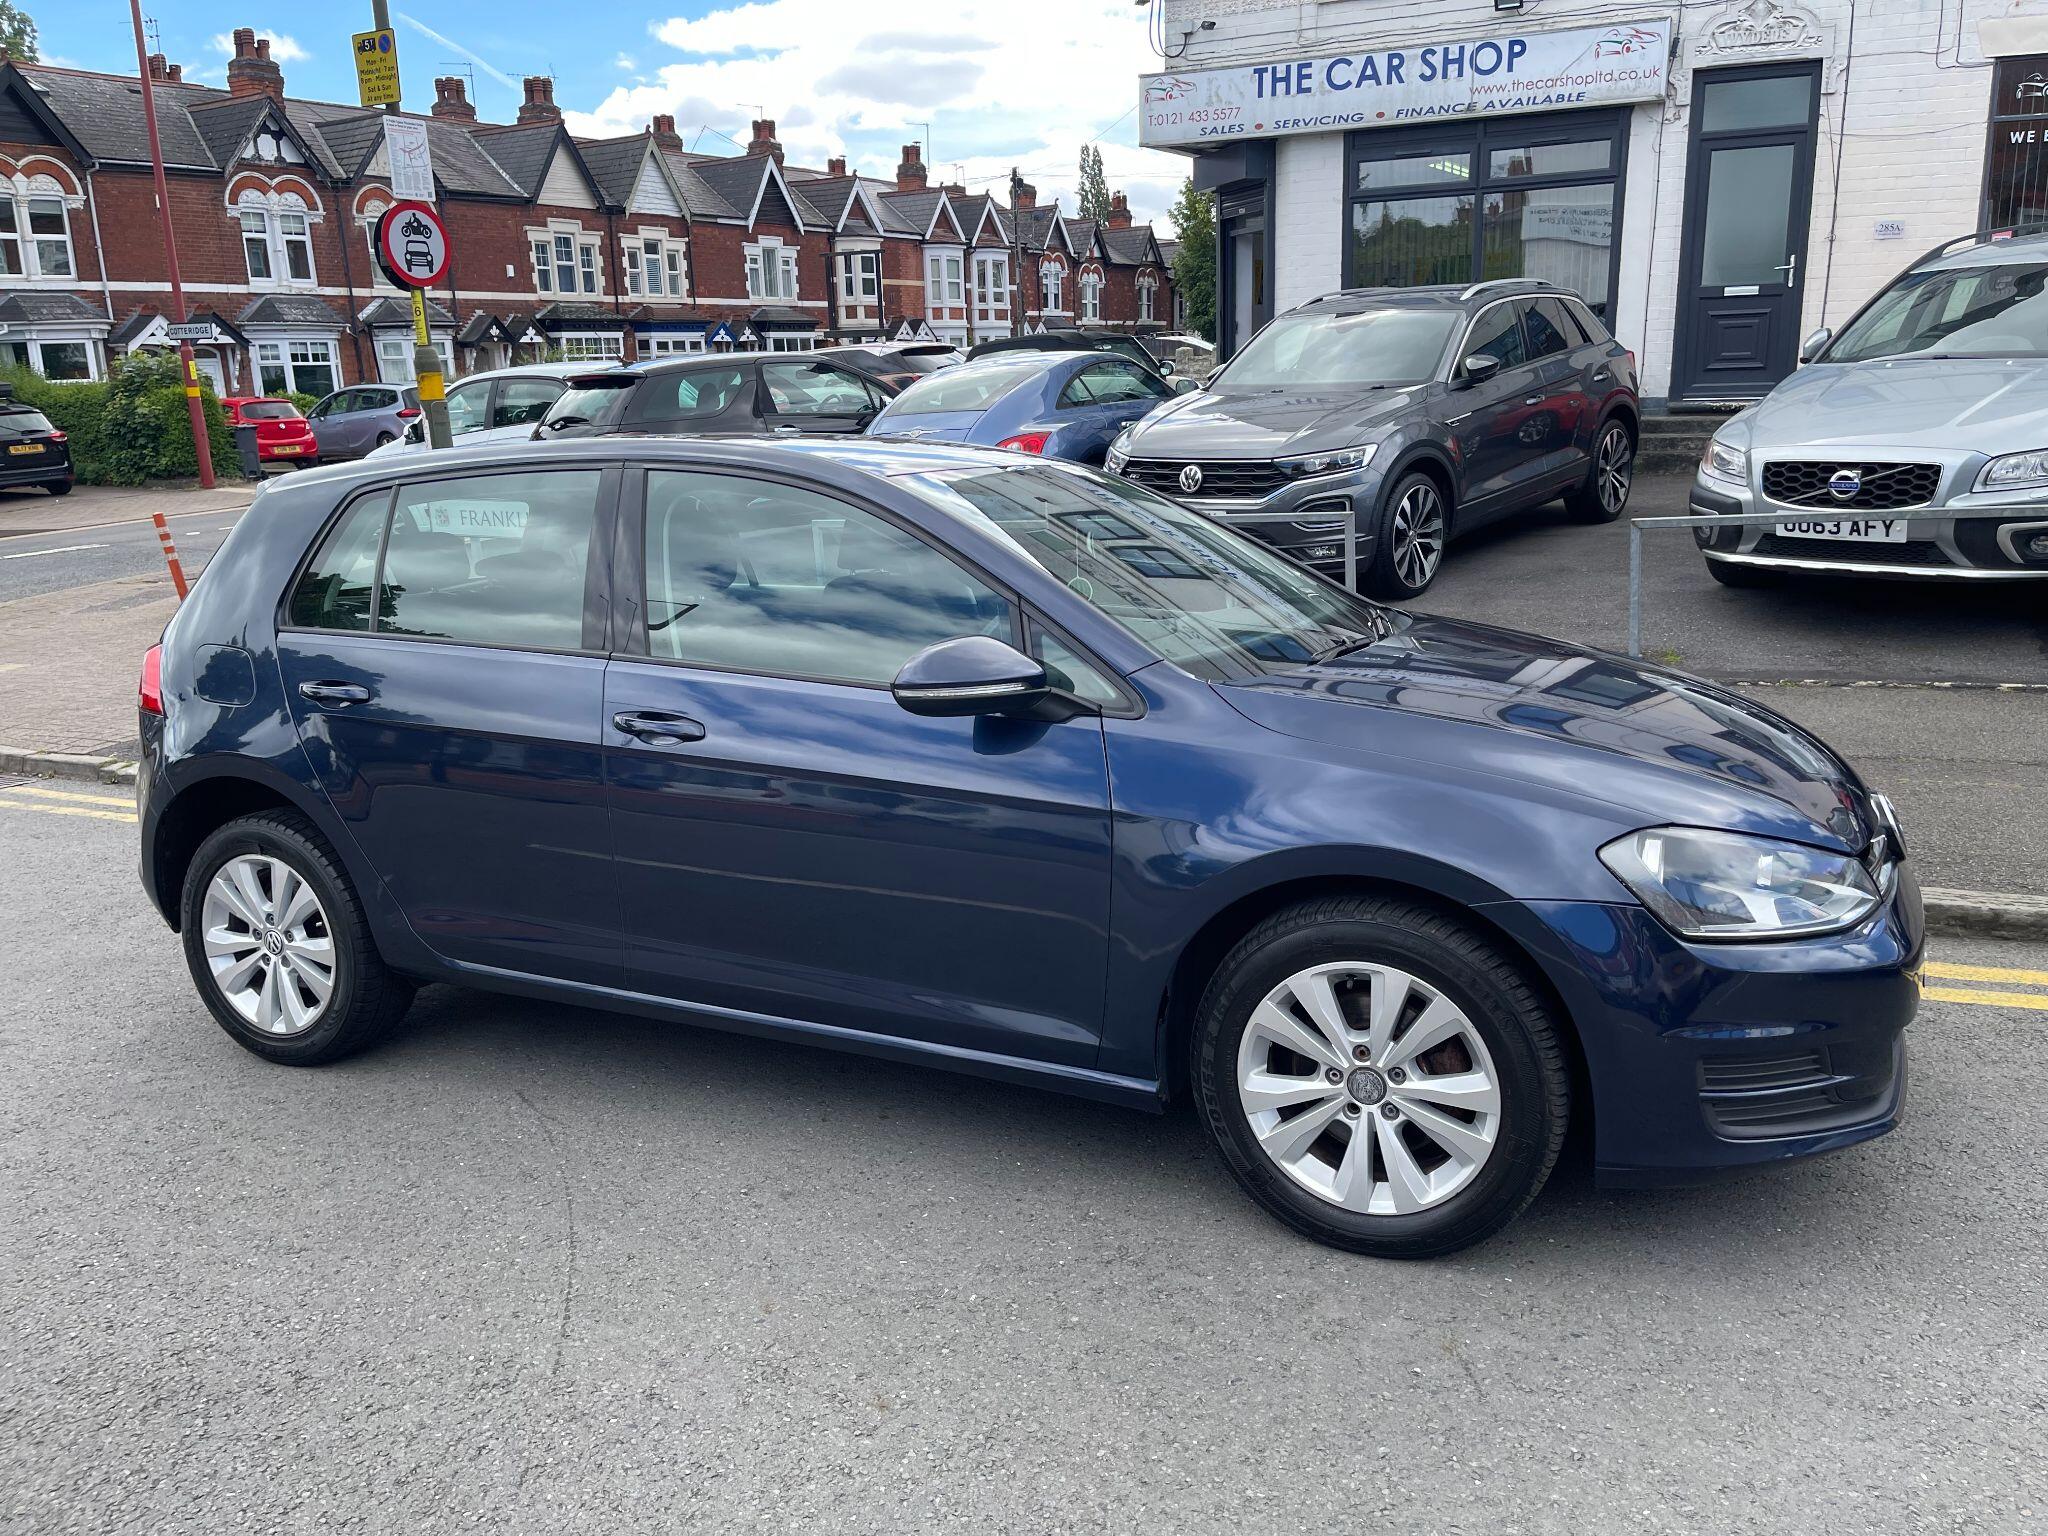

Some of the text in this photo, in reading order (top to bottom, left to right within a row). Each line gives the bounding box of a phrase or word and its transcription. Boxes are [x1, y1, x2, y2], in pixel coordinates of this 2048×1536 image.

[1253, 39, 1527, 99] THE CAR SHOP
[1469, 66, 1661, 96] www.thecarshopltd.co.uk
[1148, 106, 1241, 127] T:0121 433 5577
[1200, 91, 1587, 136] SALES SERVICING FINANCE AVAILABLE
[2010, 130, 2036, 144] WE
[1879, 223, 1901, 233] 285A
[414, 306, 422, 317] 6
[170, 326, 209, 335] COTTERIDGE
[1849, 520, 1895, 537] AFY
